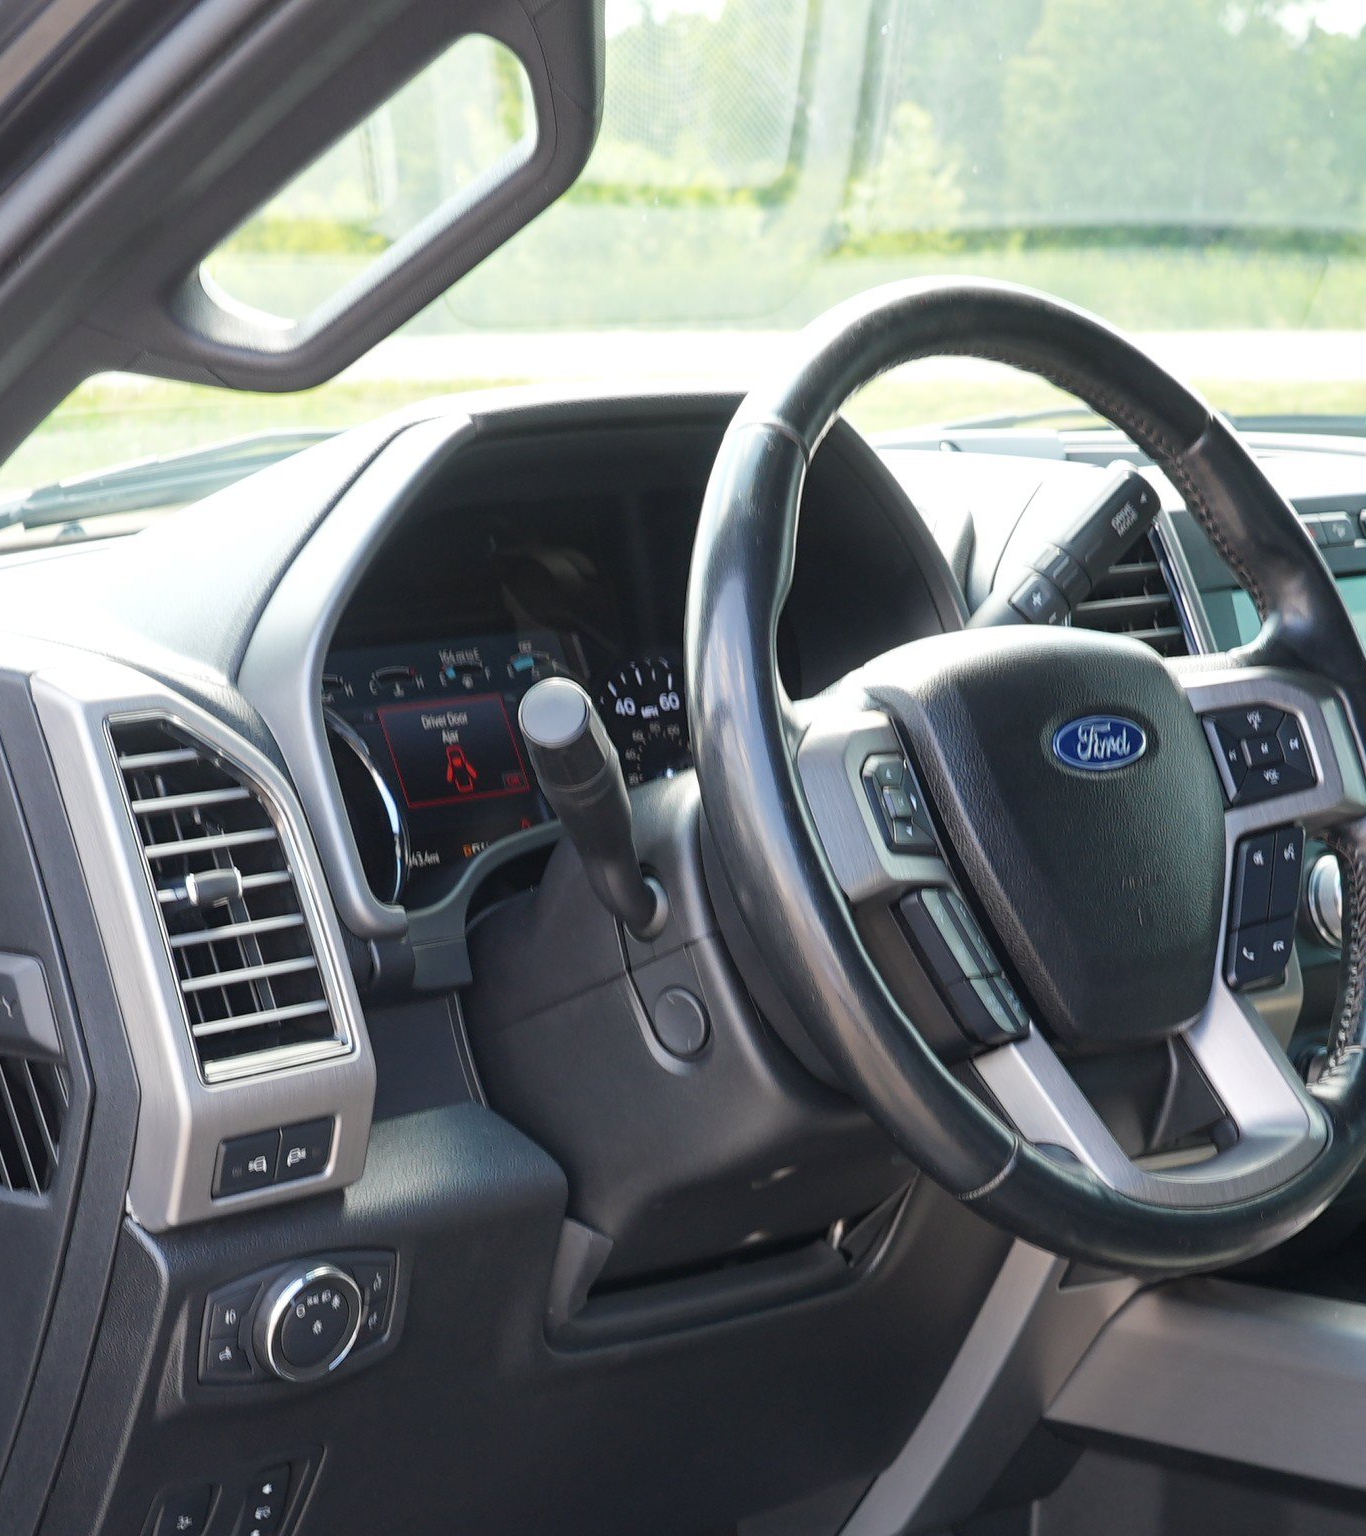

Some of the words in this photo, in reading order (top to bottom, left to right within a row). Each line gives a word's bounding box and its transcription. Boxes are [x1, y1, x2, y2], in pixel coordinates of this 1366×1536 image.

[615, 697, 637, 717] 40
[659, 691, 681, 711] 60
[420, 714, 446, 731] Driver
[446, 711, 469, 727] Door
[441, 729, 460, 746] Ajar
[1076, 722, 1131, 761] Ford
